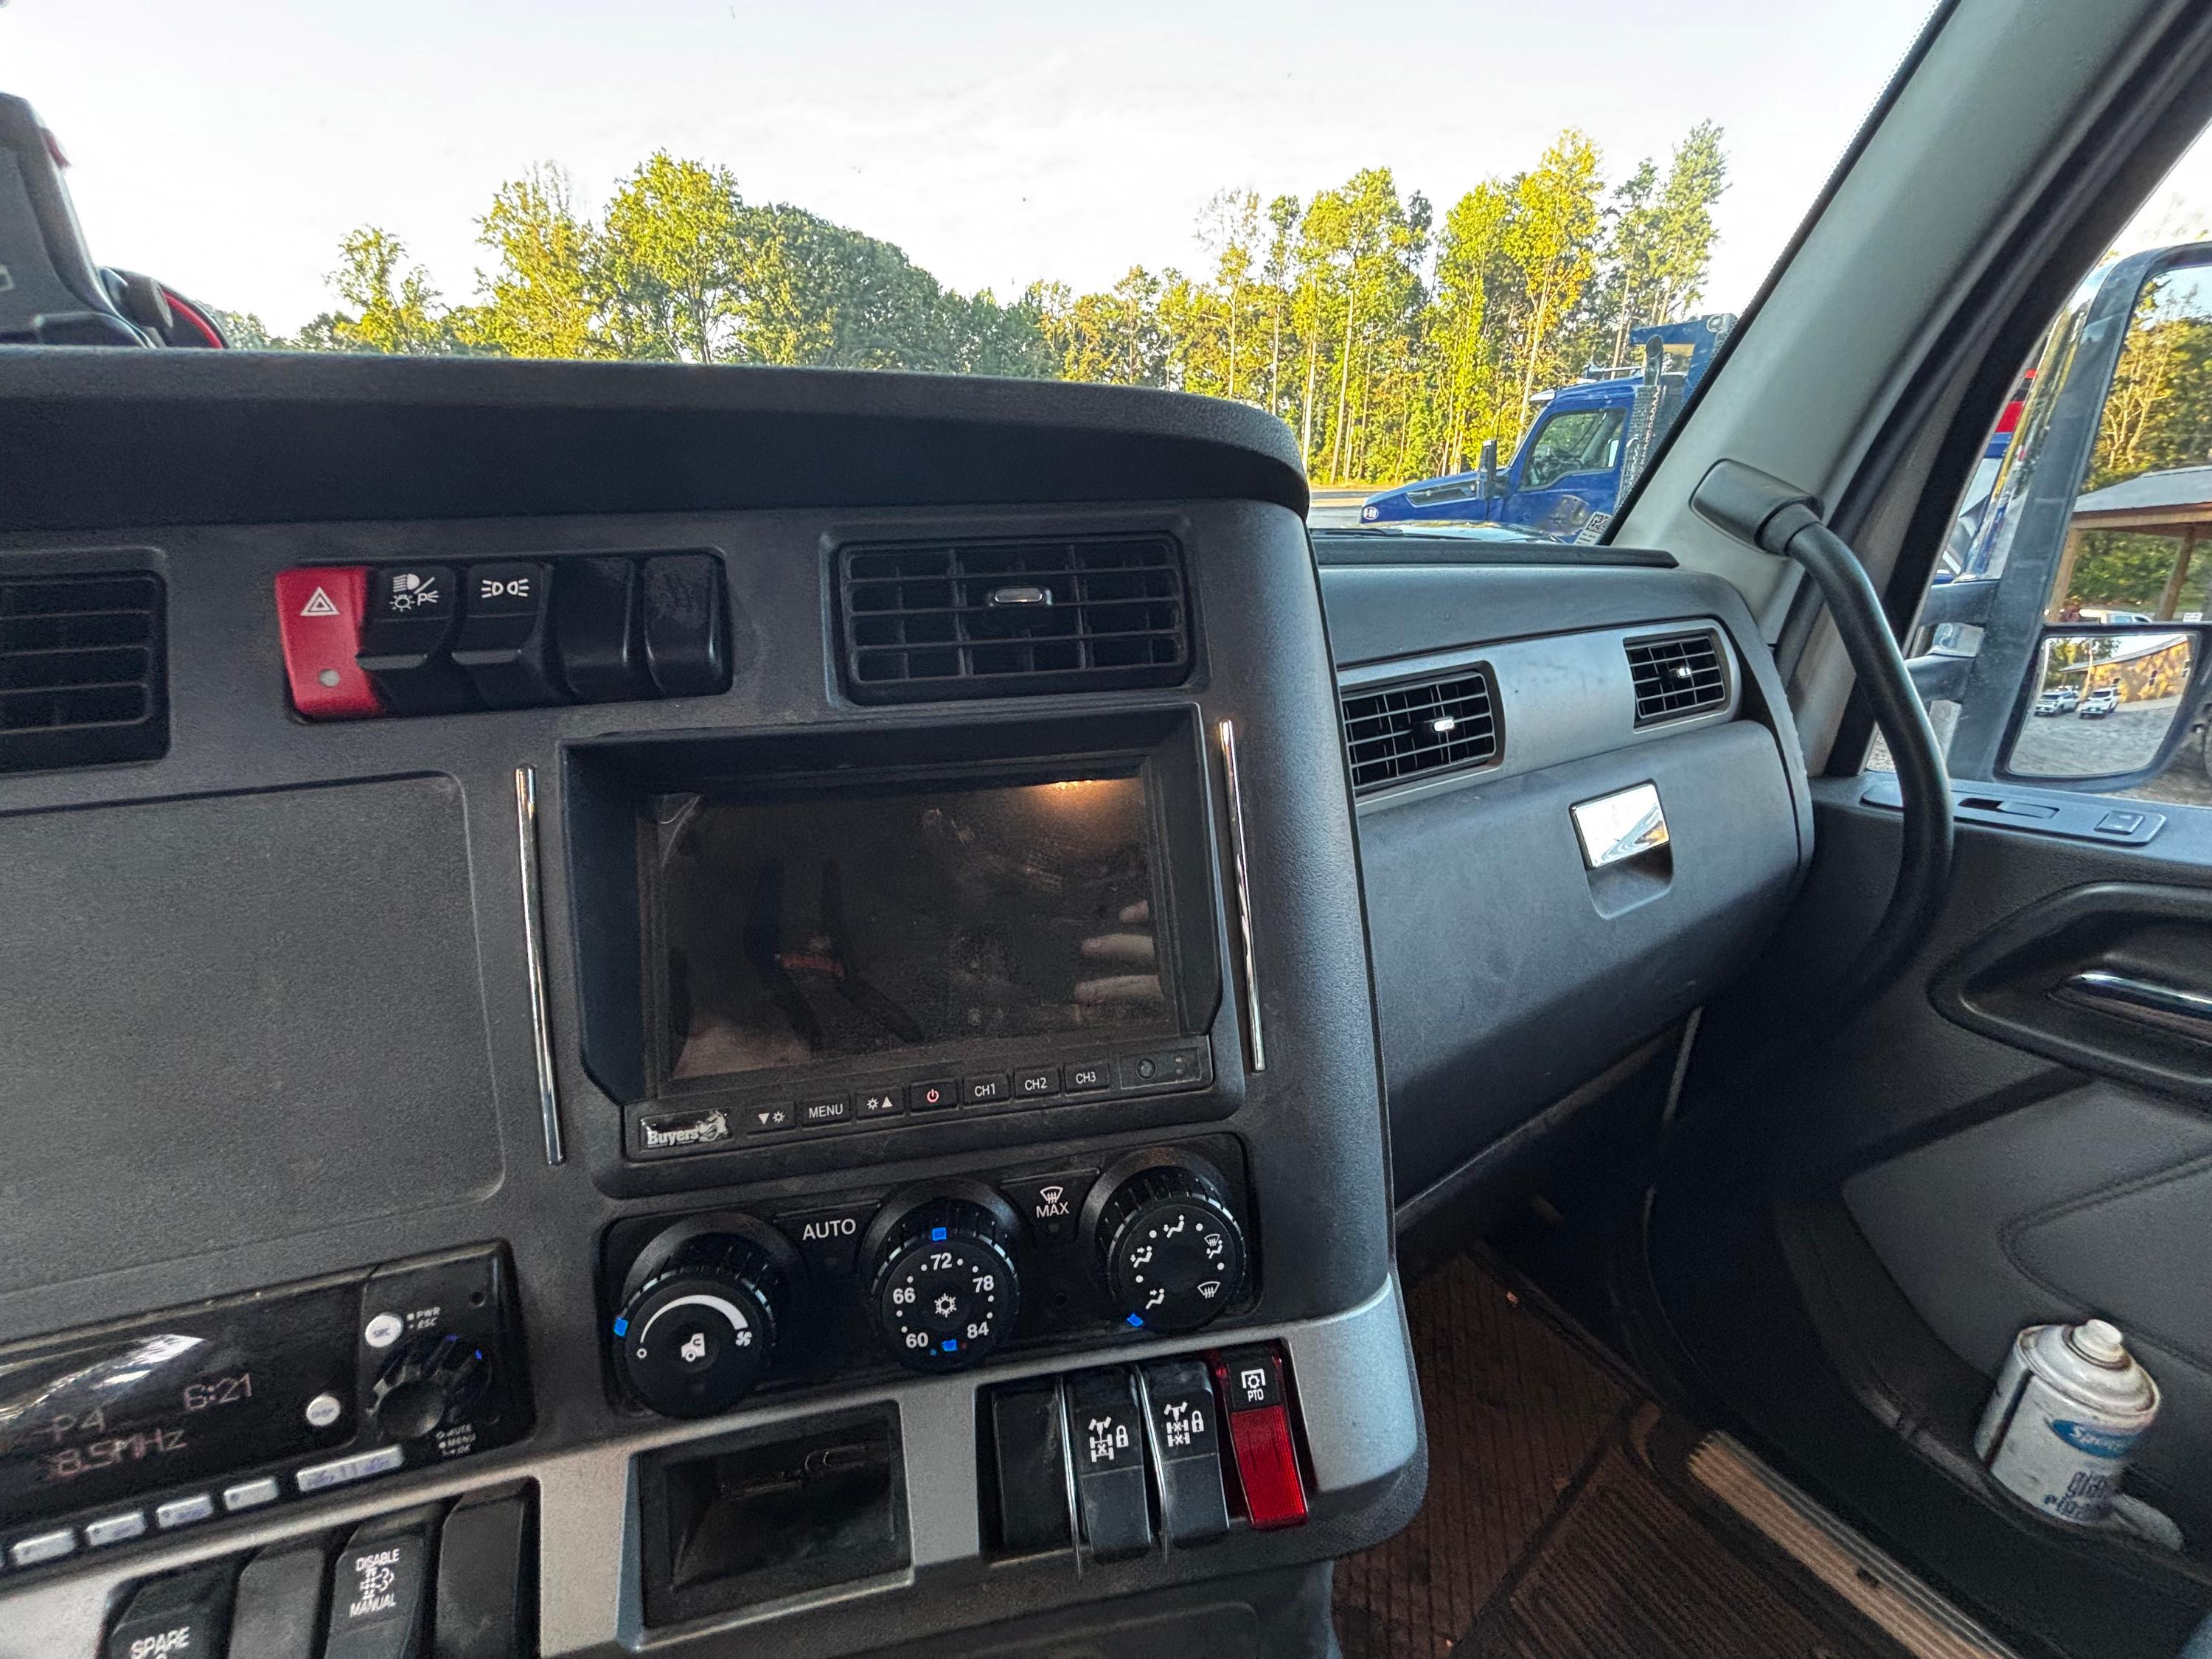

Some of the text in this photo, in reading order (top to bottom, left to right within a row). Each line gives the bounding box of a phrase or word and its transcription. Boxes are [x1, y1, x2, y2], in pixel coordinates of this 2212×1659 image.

[1025, 1078, 1047, 1091] CH2
[1076, 1072, 1096, 1085] CH3
[975, 1084, 995, 1096] CH1
[809, 1104, 844, 1119] MENU
[647, 1128, 699, 1146] Buyers
[1036, 1202, 1069, 1218] MAX
[802, 1219, 856, 1240] AUTO
[931, 1253, 953, 1270] 72
[973, 1275, 994, 1293] 78
[893, 1287, 916, 1304] 66
[417, 1307, 440, 1319] PWR
[967, 1322, 989, 1339] 84
[906, 1332, 928, 1348] 60
[185, 1373, 252, 1411] 6:21
[1248, 1388, 1264, 1402] PTO
[355, 1548, 400, 1571] DISABLE
[349, 1593, 397, 1618] MANUAL
[130, 1626, 189, 1659] SPARE
